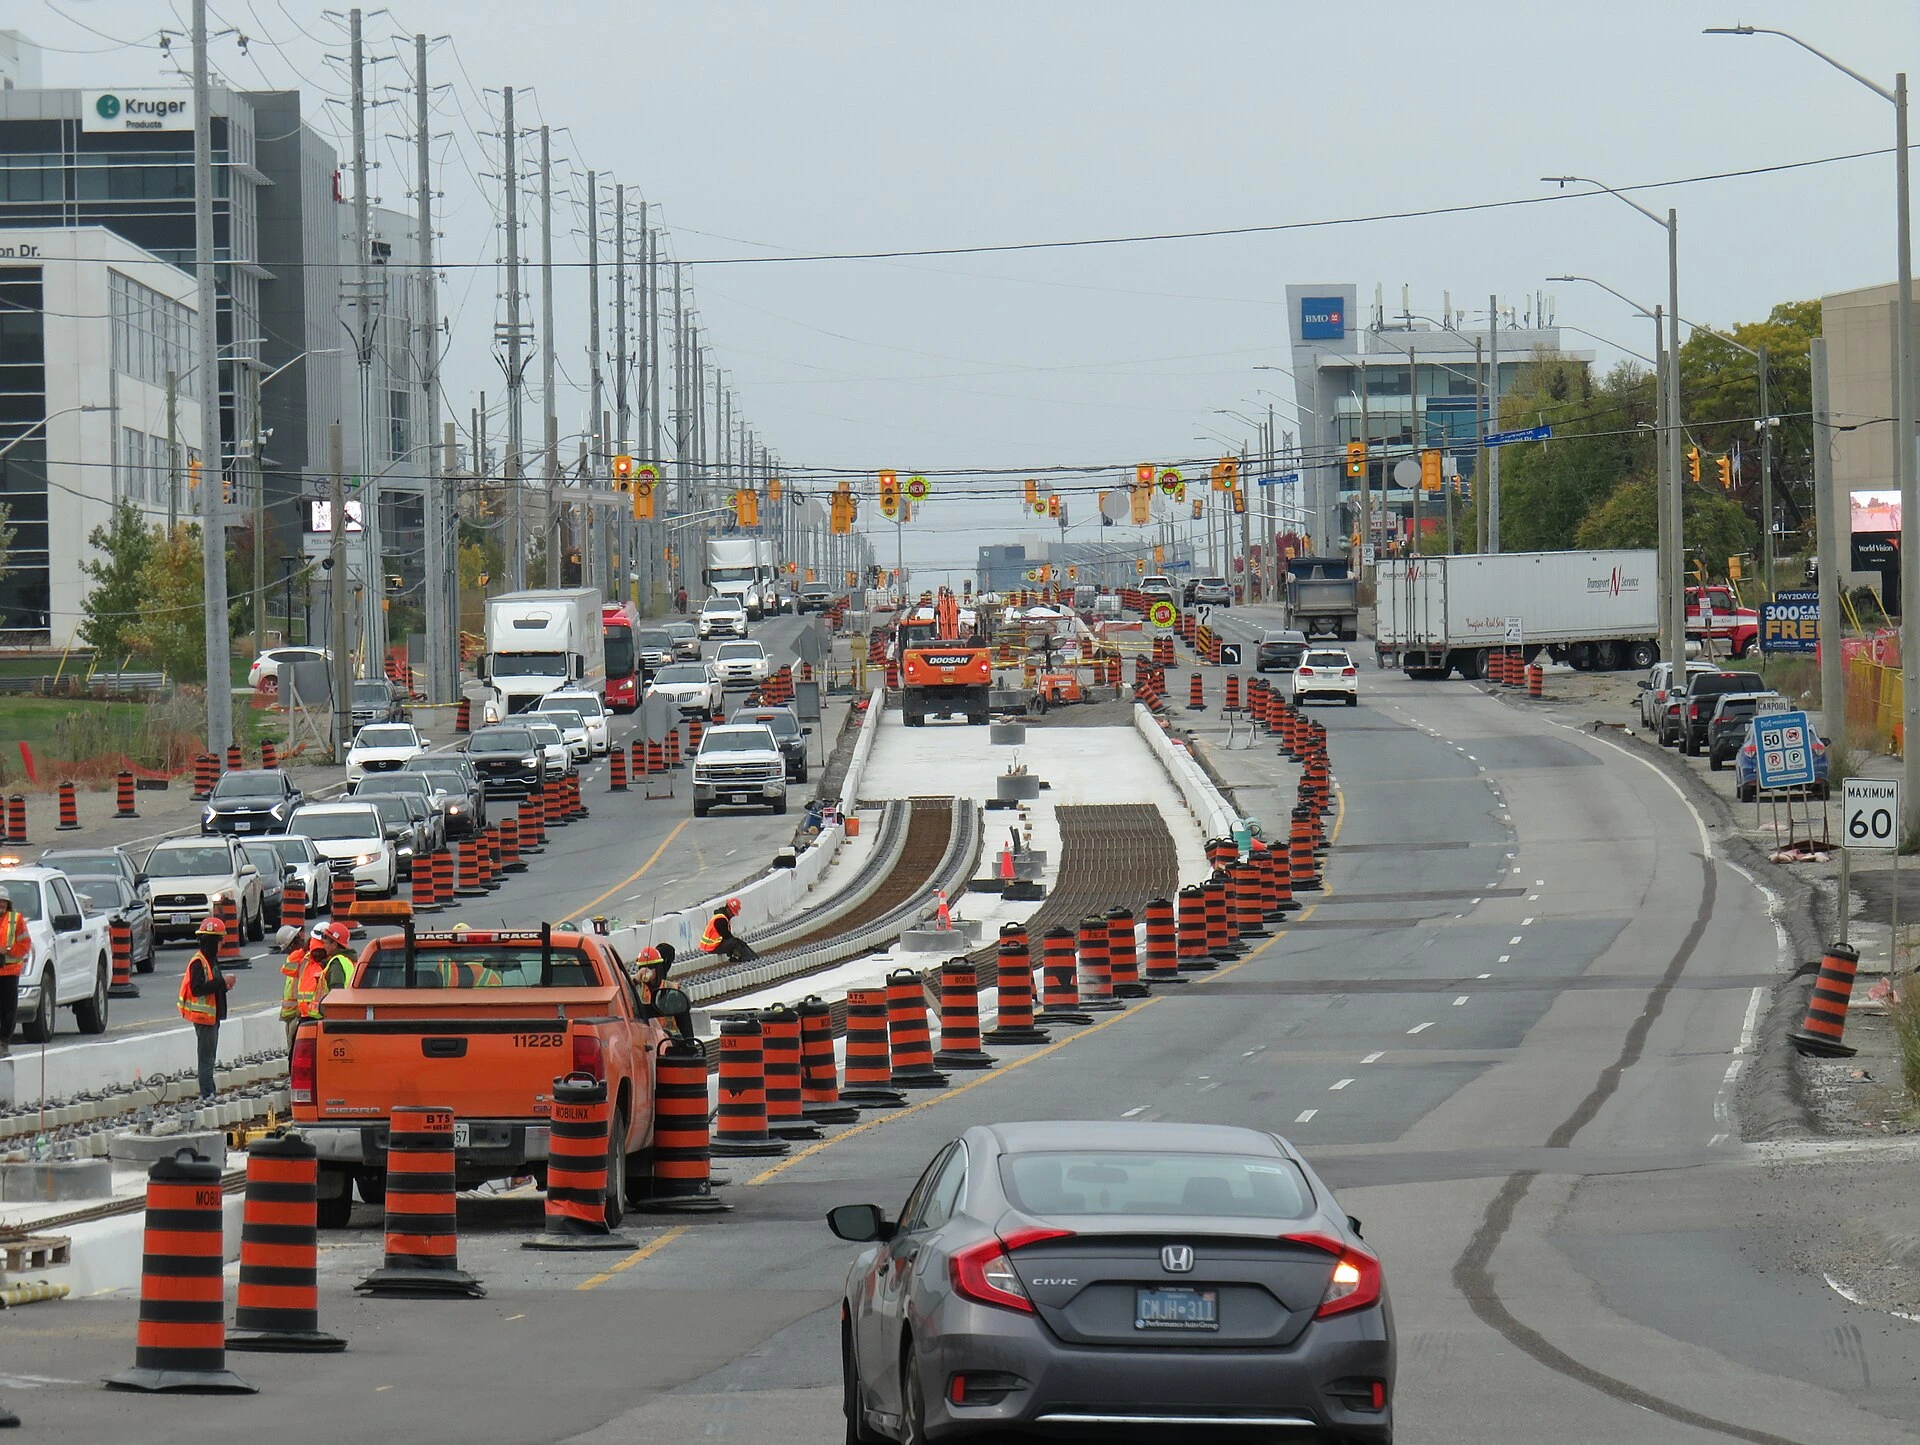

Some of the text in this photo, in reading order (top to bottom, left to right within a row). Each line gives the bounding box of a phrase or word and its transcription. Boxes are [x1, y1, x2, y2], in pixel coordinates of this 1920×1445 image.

[125, 99, 186, 117] Kruger
[20, 244, 40, 257] Dr.
[1305, 314, 1329, 323] BMO
[910, 484, 924, 494] NEW
[1876, 544, 1893, 552] Vision
[1587, 577, 1609, 589] Transport
[1621, 577, 1638, 587] Service
[1155, 610, 1170, 620] NEW
[1759, 702, 1787, 711] CARPOOL
[1764, 734, 1779, 746] 50
[1848, 788, 1894, 798] MAXIMUM
[1849, 808, 1892, 839] 60
[500, 932, 539, 940] RACK
[513, 1034, 563, 1048] 11228
[333, 1047, 345, 1057] 65
[426, 1114, 451, 1124] BTS
[455, 1130, 467, 1143] 57
[1032, 1278, 1079, 1286] CIVIC
[1145, 1320, 1182, 1328] Performance
